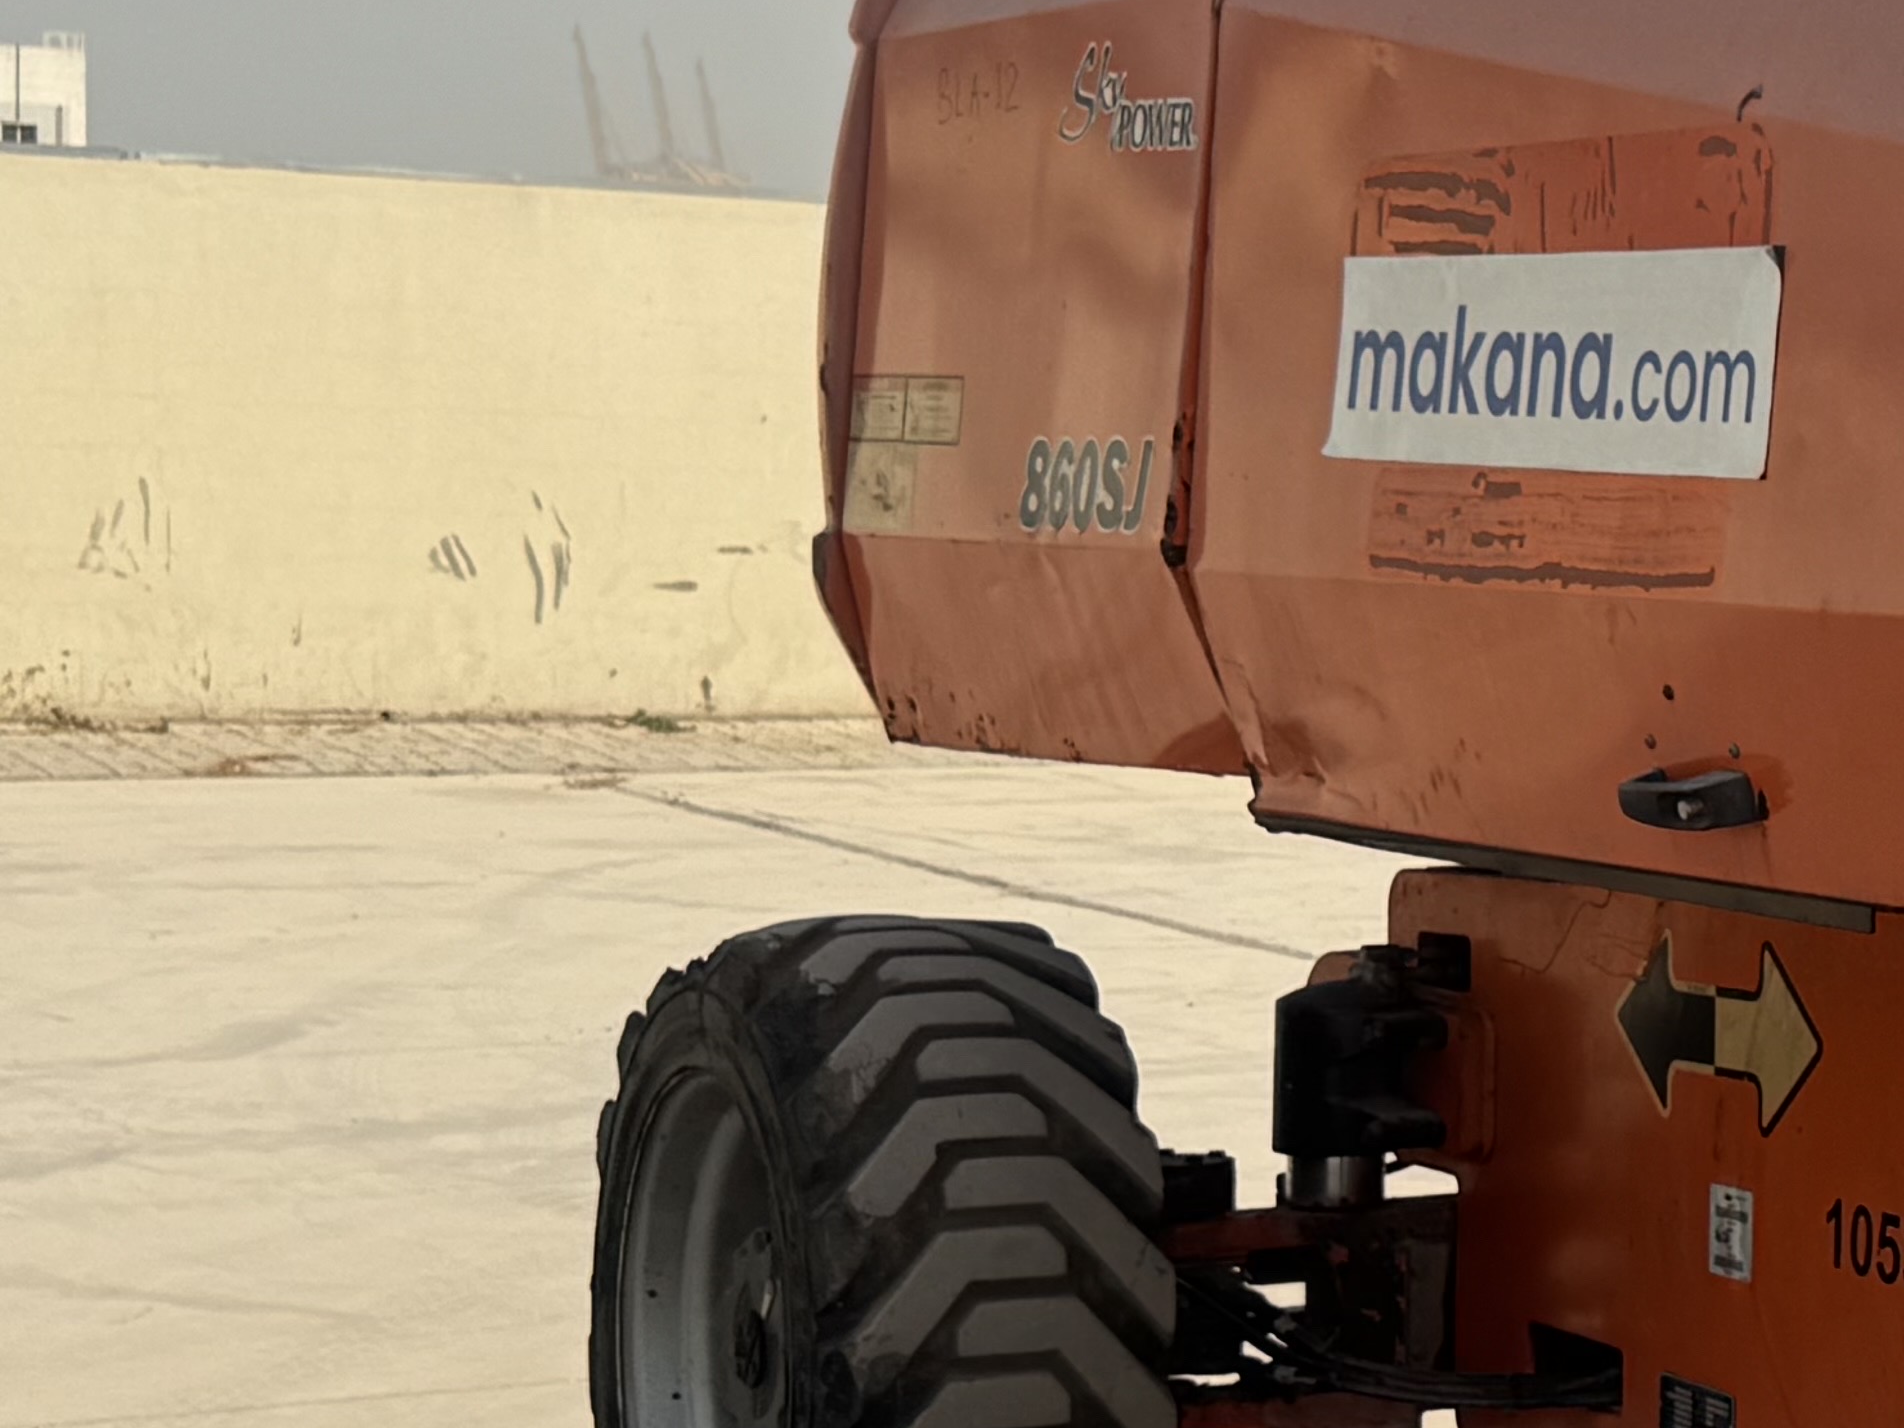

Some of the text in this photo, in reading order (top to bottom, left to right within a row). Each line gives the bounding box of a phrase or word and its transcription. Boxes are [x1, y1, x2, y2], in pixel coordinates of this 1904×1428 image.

[1109, 97, 1198, 151] POWER
[1347, 305, 1756, 423] makana.com
[1019, 435, 1155, 534] 860SJ
